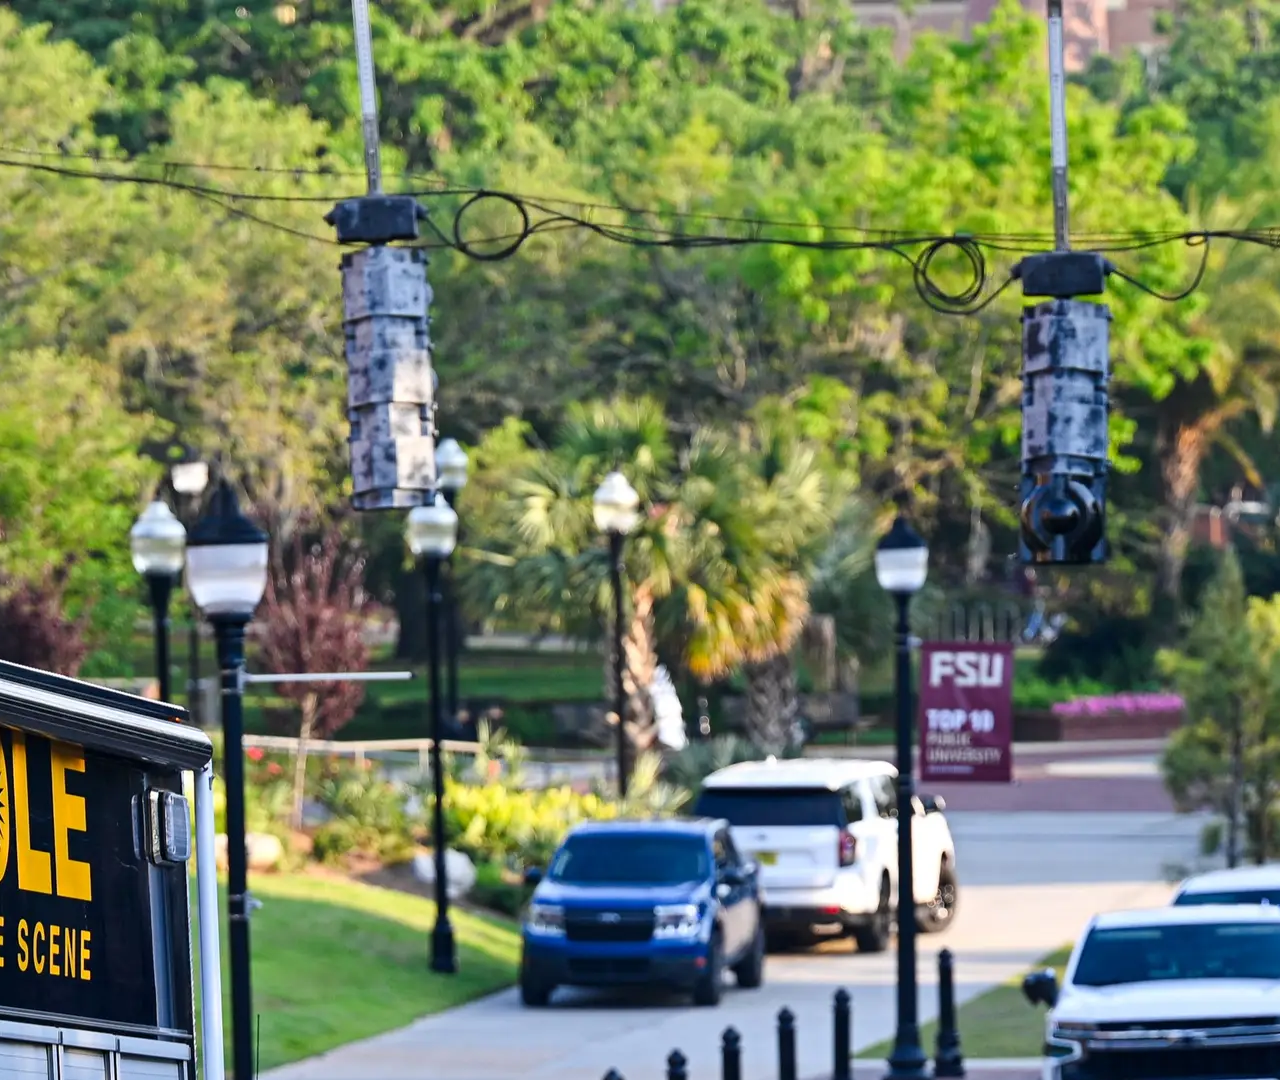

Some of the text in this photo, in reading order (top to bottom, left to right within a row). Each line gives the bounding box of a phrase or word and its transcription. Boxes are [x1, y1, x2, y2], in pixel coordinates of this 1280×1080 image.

[929, 651, 1004, 687] FSU
[926, 708, 995, 733] TOP 10
[17, 918, 91, 981] SCENE
